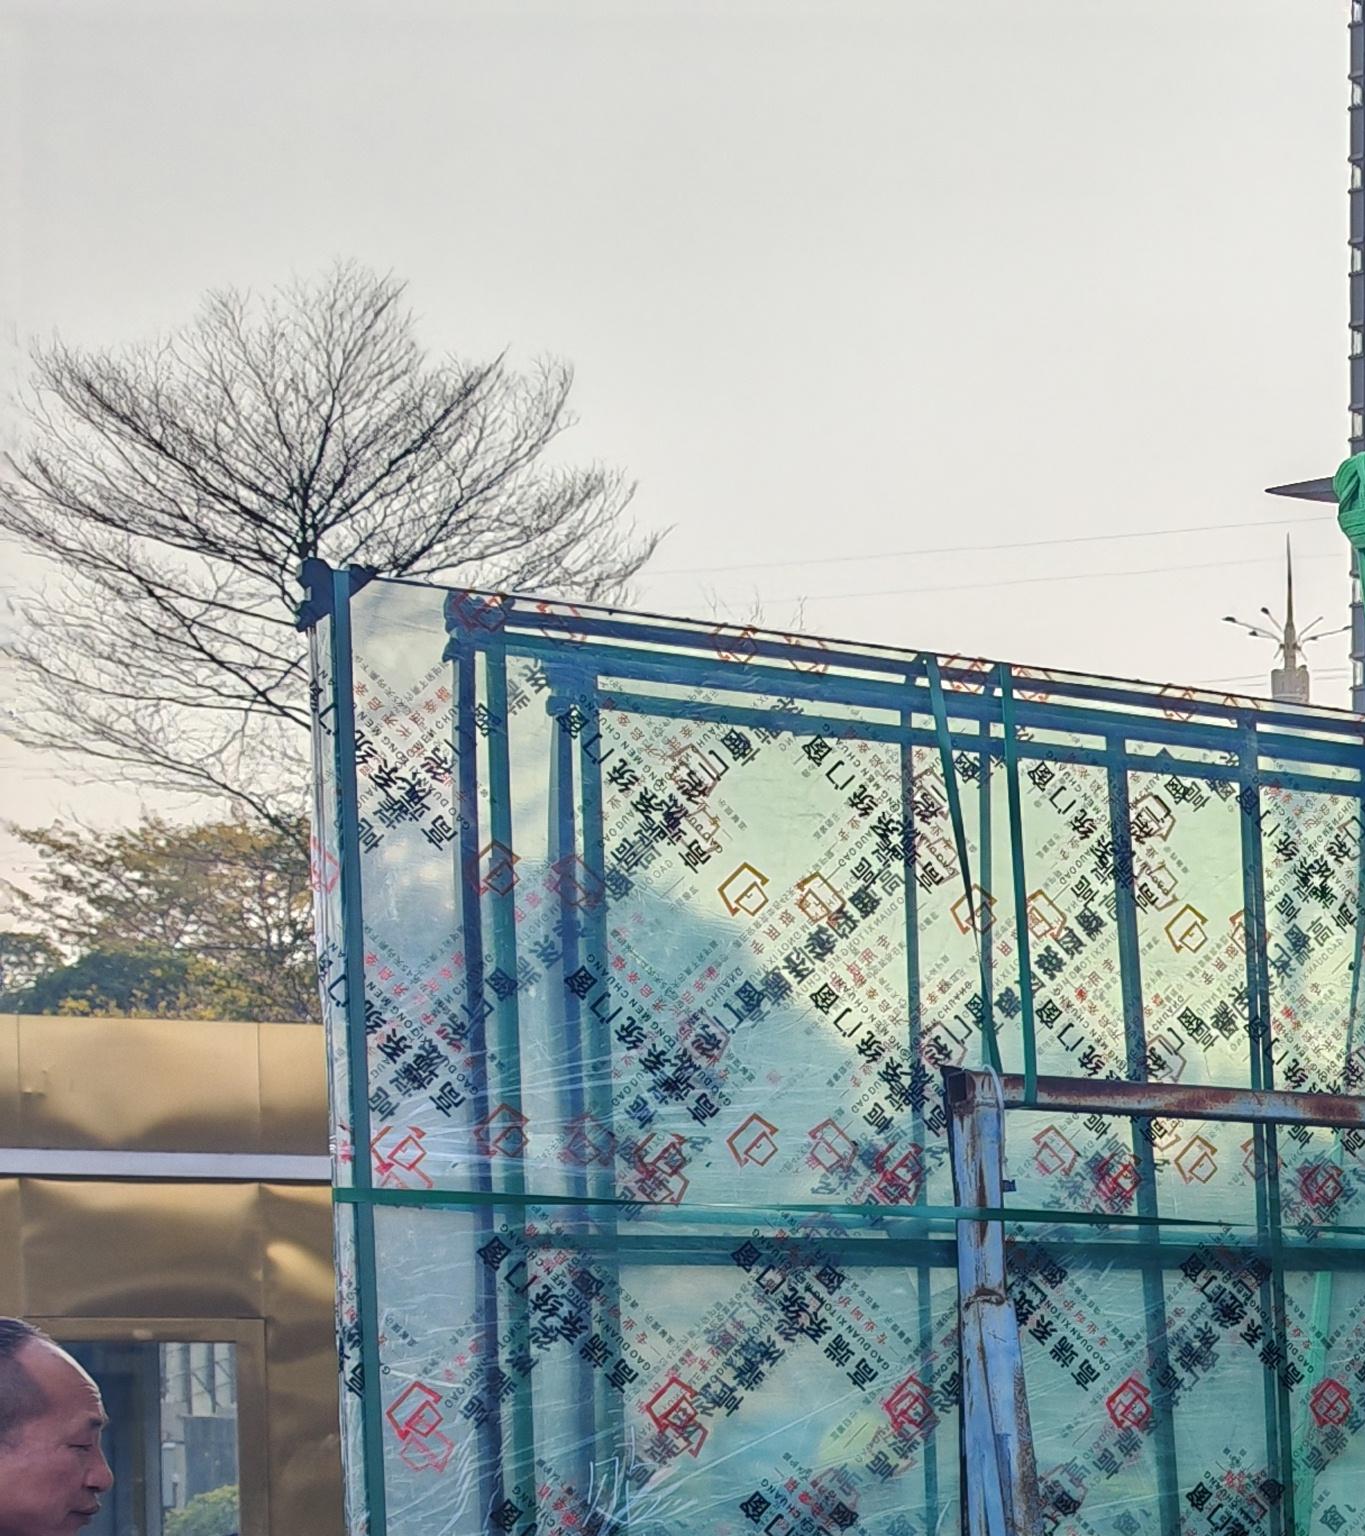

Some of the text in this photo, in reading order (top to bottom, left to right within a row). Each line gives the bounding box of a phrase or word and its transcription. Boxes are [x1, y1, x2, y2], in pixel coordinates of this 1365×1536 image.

[551, 700, 714, 875] 高端系统门窗
[560, 961, 723, 1128] 高端系统门窗
[805, 979, 955, 1138] 高端系统门窗
[474, 1231, 639, 1394] 高端系统门窗
[728, 1236, 882, 1392] 高端系统门窗
